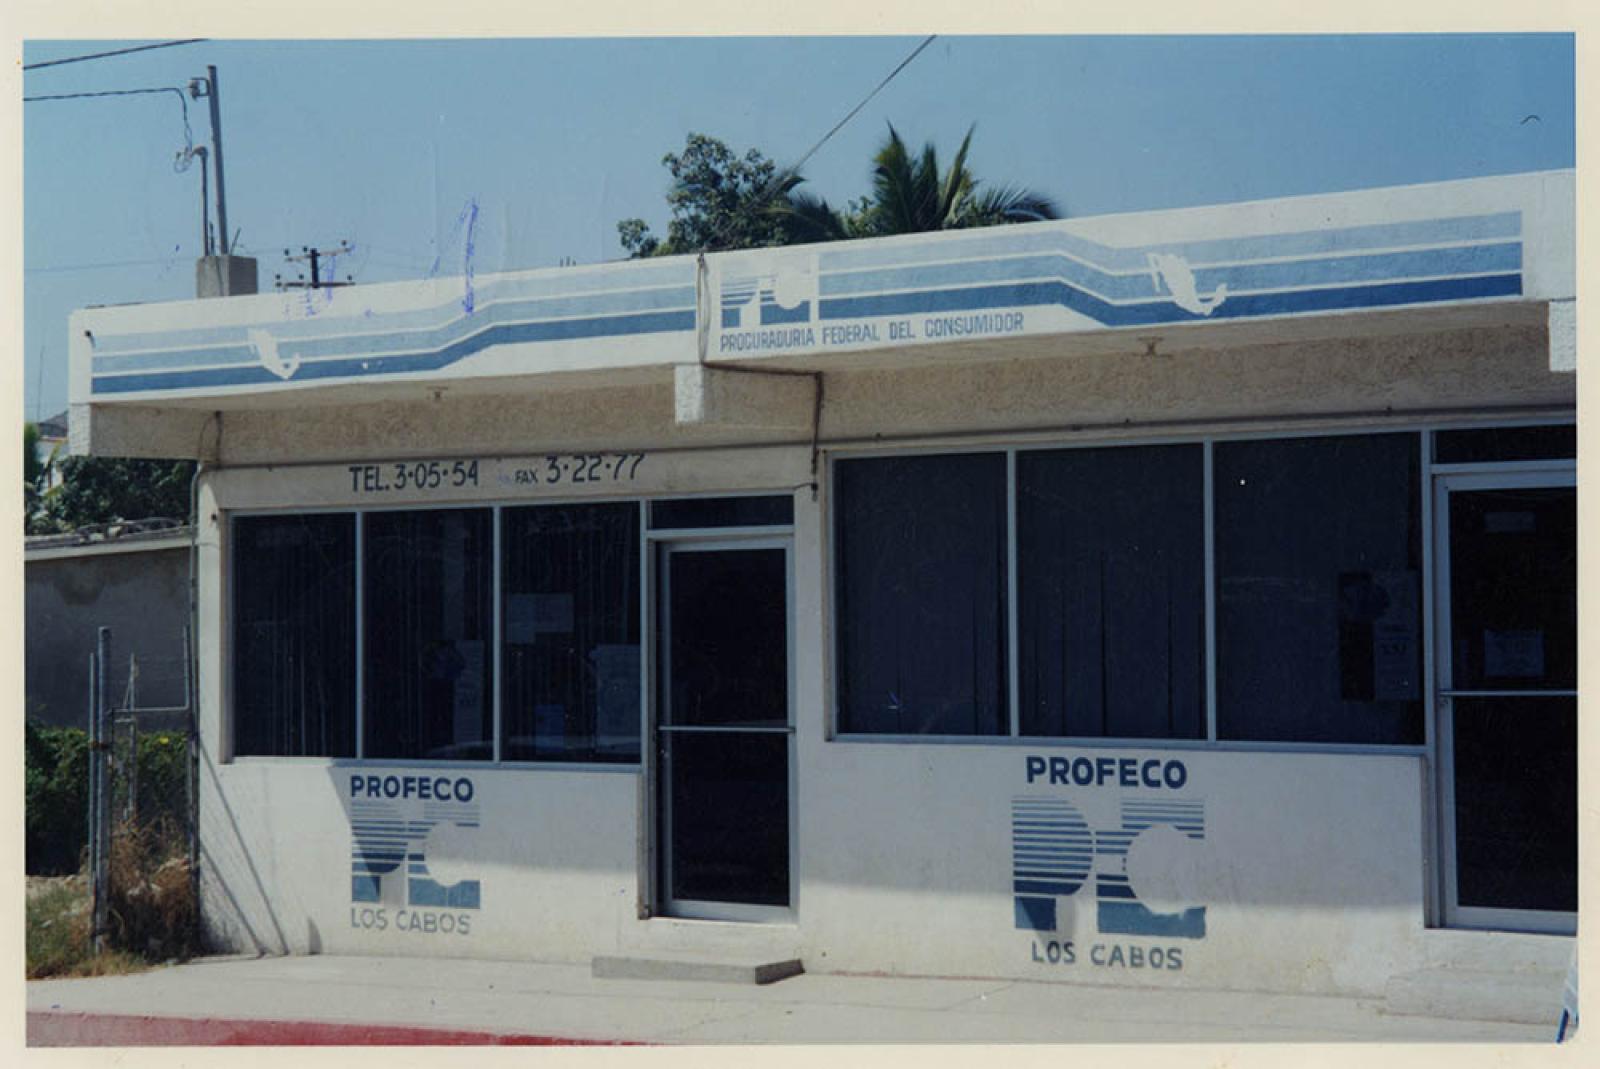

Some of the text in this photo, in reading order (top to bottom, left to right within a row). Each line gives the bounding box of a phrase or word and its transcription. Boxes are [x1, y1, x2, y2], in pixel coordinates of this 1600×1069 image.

[720, 311, 1025, 352] PROCURADURIA FEDERAL DEL CONSUMIDOR
[515, 469, 539, 485] FAX
[1025, 756, 1188, 789] PROFECO
[351, 775, 474, 803] PROFECO
[351, 908, 471, 936] LOS CABOS
[1031, 940, 1184, 971] LOS CABOS
